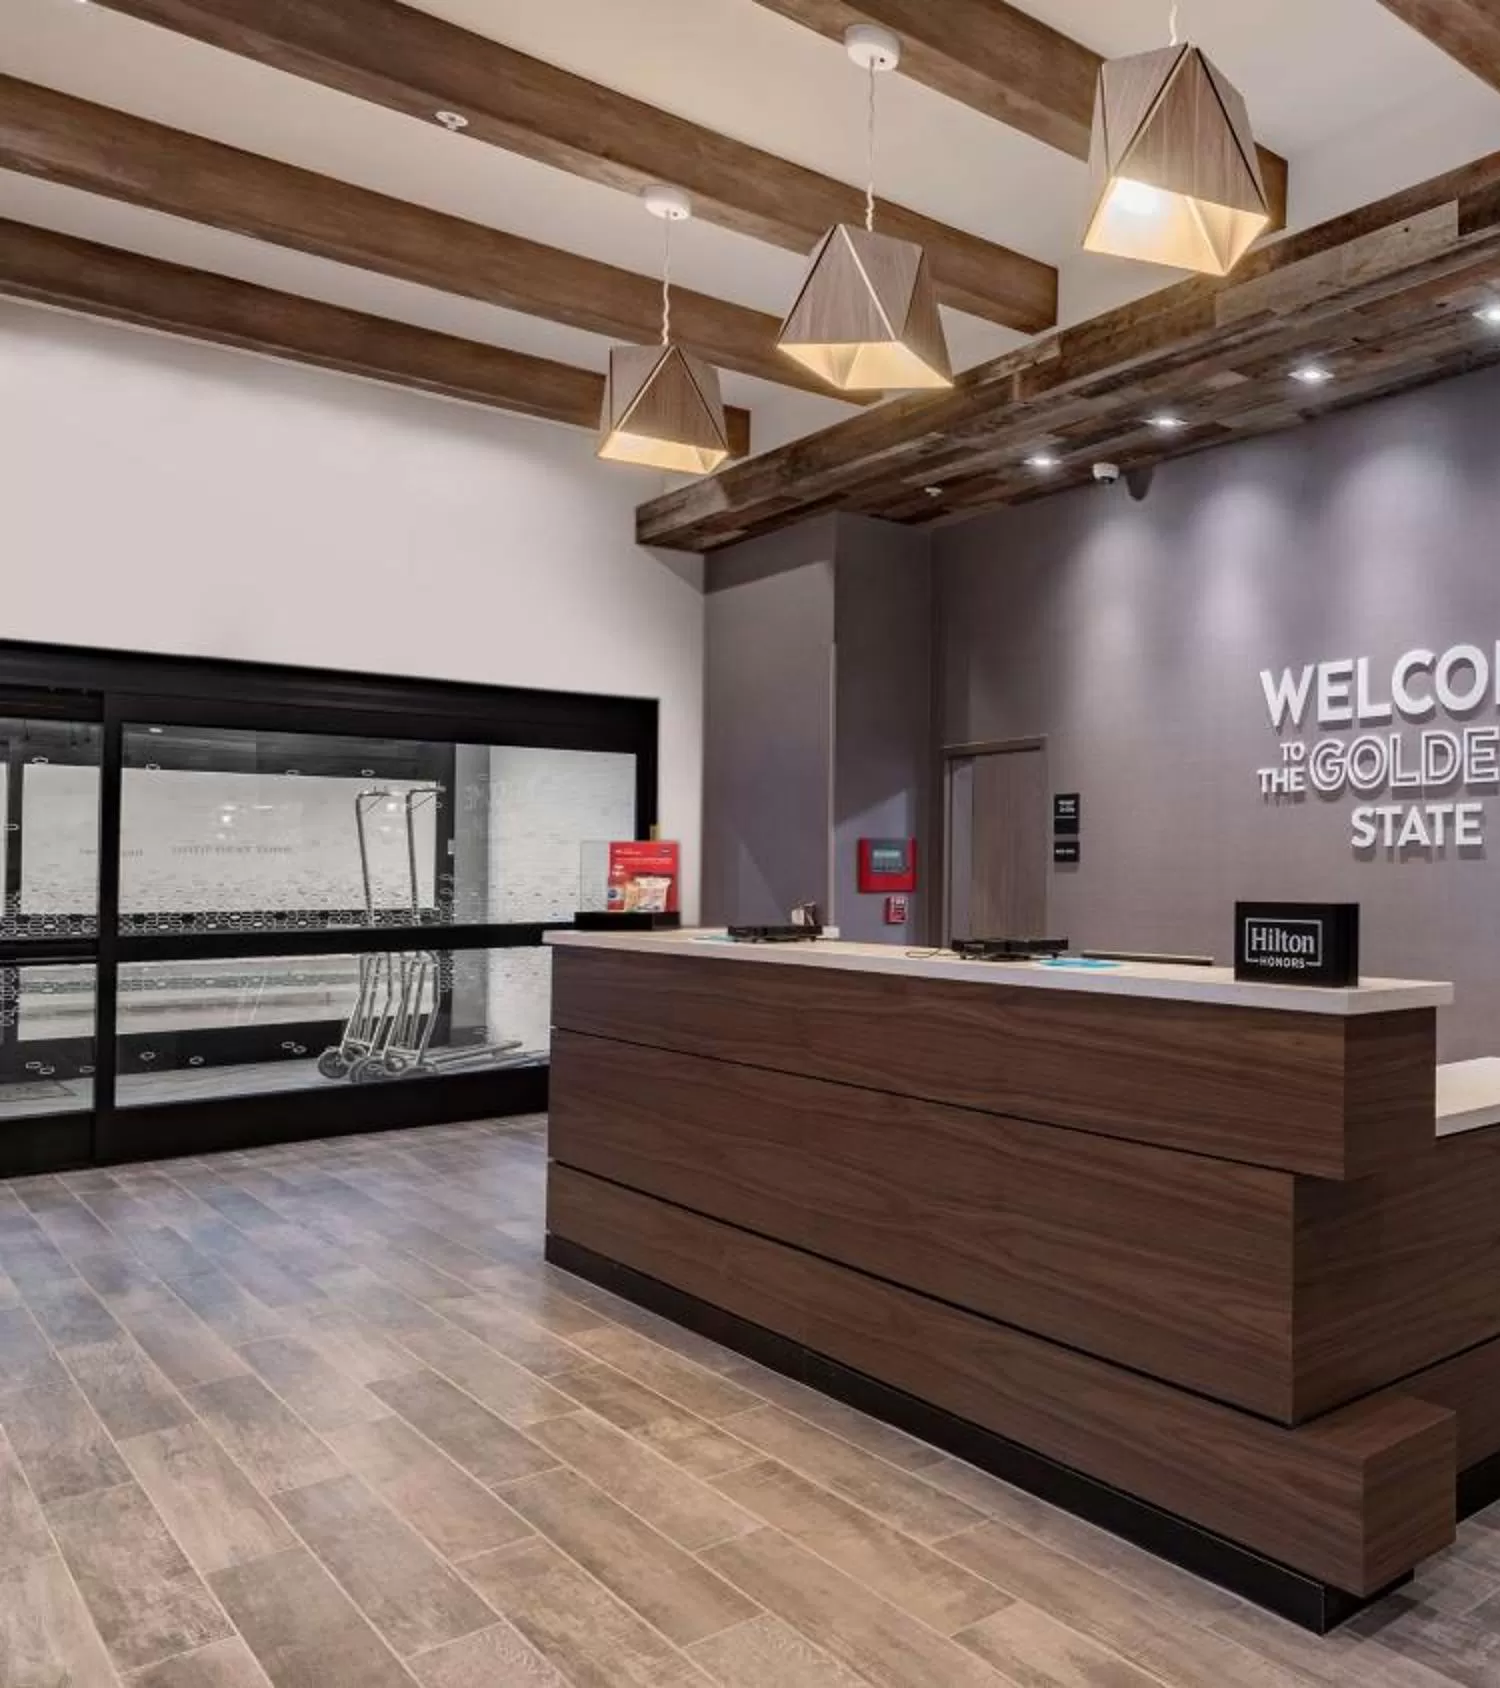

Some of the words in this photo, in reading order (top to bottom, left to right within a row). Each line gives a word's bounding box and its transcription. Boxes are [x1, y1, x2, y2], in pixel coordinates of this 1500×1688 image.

[1280, 742, 1305, 762] TO
[1257, 767, 1305, 794] THE
[1351, 803, 1483, 848] STATE
[1251, 927, 1315, 955] Hilton
[1260, 956, 1306, 969] HONORS
